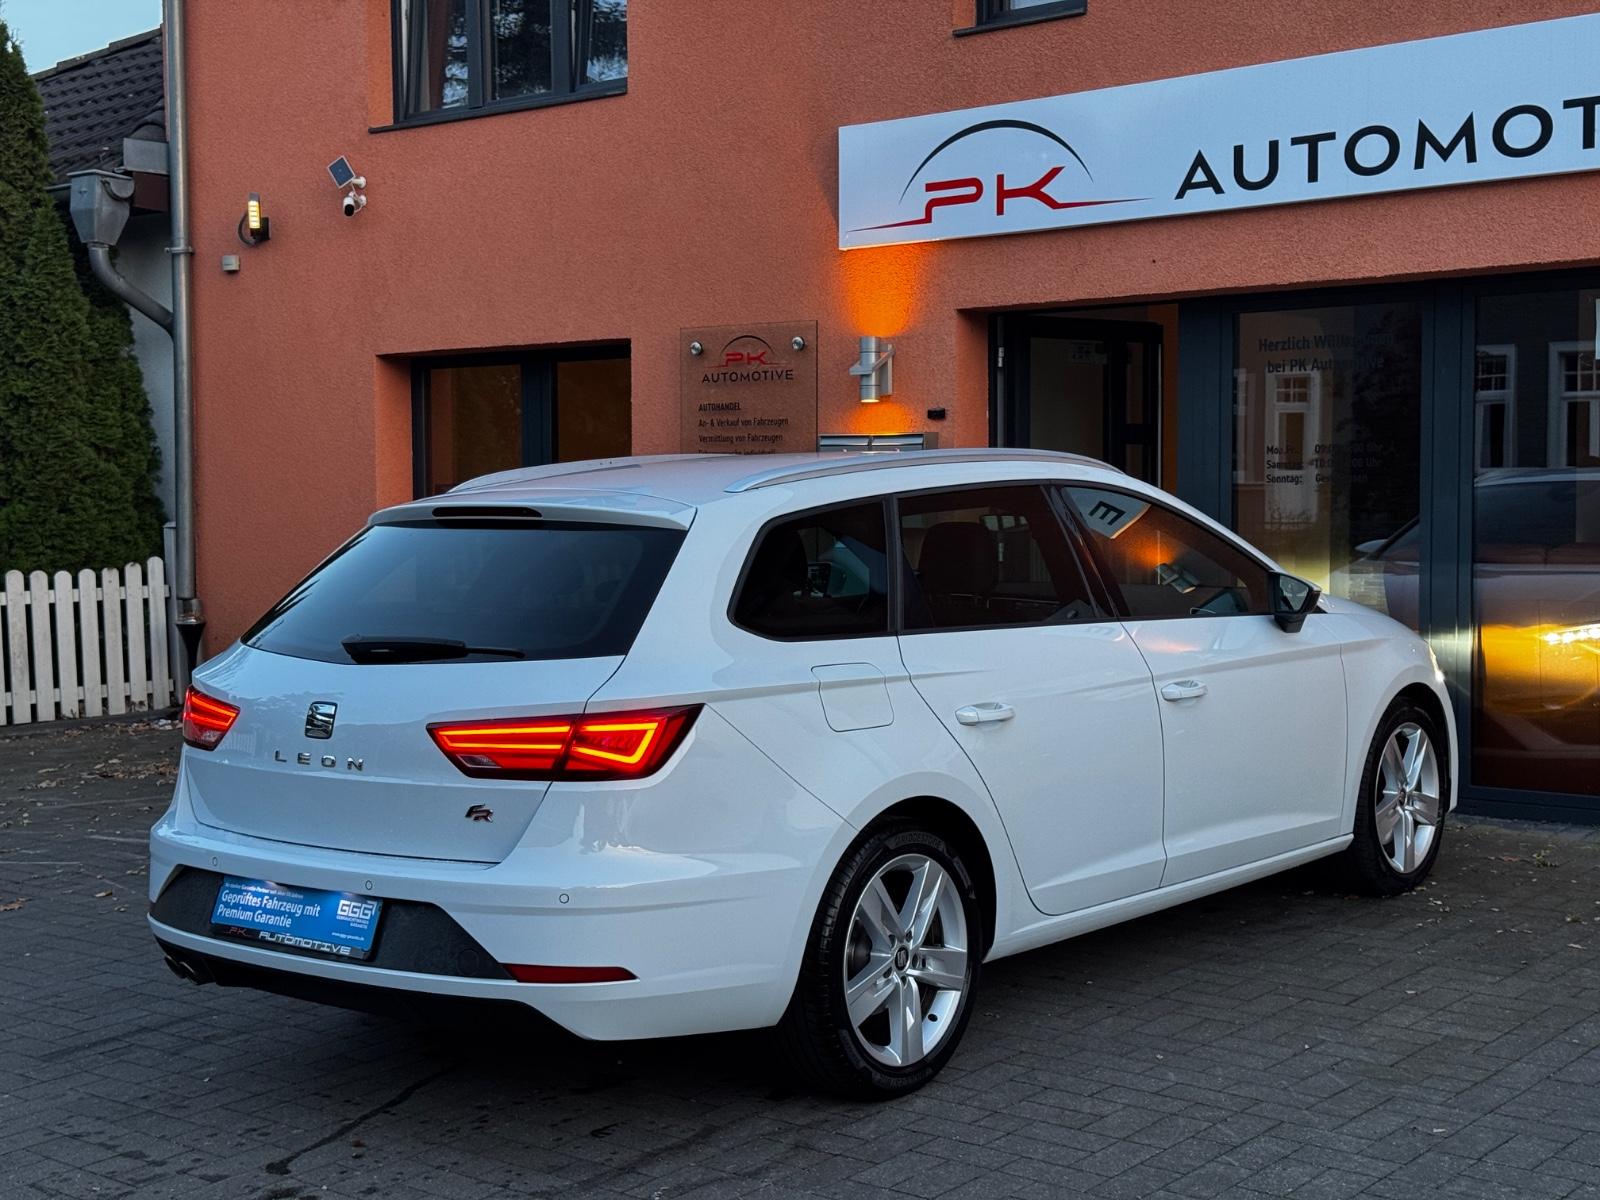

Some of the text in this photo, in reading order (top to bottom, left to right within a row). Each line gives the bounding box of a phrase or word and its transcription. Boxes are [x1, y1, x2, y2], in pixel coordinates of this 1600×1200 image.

[1174, 94, 1600, 201] AUTOMOT
[1258, 335, 1310, 352] Herzlich
[1267, 360, 1286, 374] bei
[1289, 359, 1307, 372] PK
[702, 369, 794, 384] AUTOMOTIVE
[698, 402, 741, 412] AUTOHANDEL
[716, 417, 740, 427] Verkauf
[753, 417, 789, 428] Fahrzeugen
[747, 433, 783, 444] Fahrzeugen
[1266, 474, 1303, 486] Sonntag:
[274, 750, 364, 771] LEON
[221, 889, 321, 917] Geprüftes Fahrzeug mit
[336, 899, 374, 920] GGG
[217, 904, 292, 928] Premium Garantie
[258, 931, 352, 956] AUTOMOTIVE
